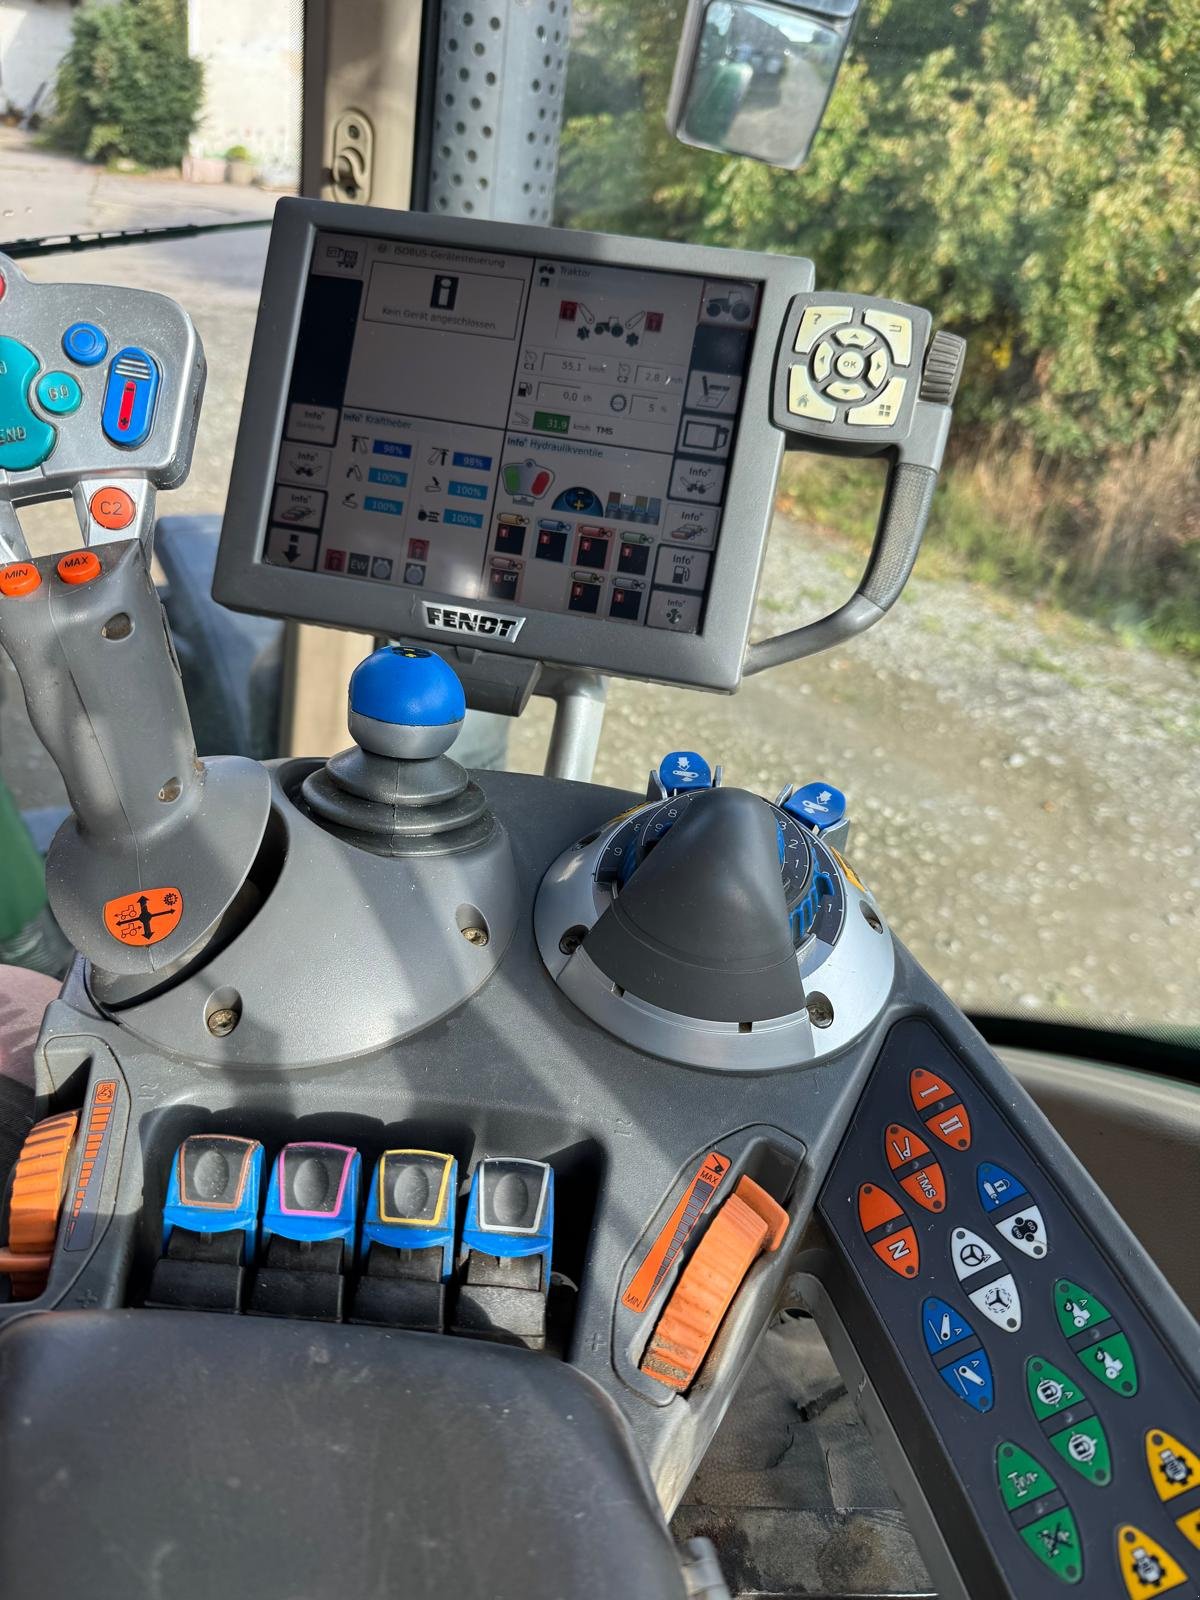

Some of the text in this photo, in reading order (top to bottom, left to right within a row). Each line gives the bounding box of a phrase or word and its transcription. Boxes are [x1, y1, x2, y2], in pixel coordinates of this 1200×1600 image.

[560, 265, 591, 277] Traktor
[382, 305, 400, 316] Kein
[403, 309, 428, 320] Gerät
[523, 363, 535, 371] C1
[616, 375, 629, 384] C2
[366, 415, 413, 428] Kraftheber
[596, 426, 614, 436] TMS
[529, 441, 604, 458] Hydraulikventile
[376, 471, 402, 484] 100%
[456, 485, 482, 497] 100%
[100, 501, 122, 515] C2
[372, 500, 398, 512] 100%
[451, 513, 478, 525] 100%
[64, 555, 89, 569] MAX
[350, 560, 368, 571] EW
[4, 569, 29, 579] MIN
[426, 607, 517, 637] FENDT
[779, 820, 787, 831] 3
[788, 838, 799, 850] 2
[700, 1170, 719, 1184] MAX
[915, 1171, 937, 1200] TMS
[888, 1239, 911, 1261] N
[625, 1293, 642, 1308] MIN
